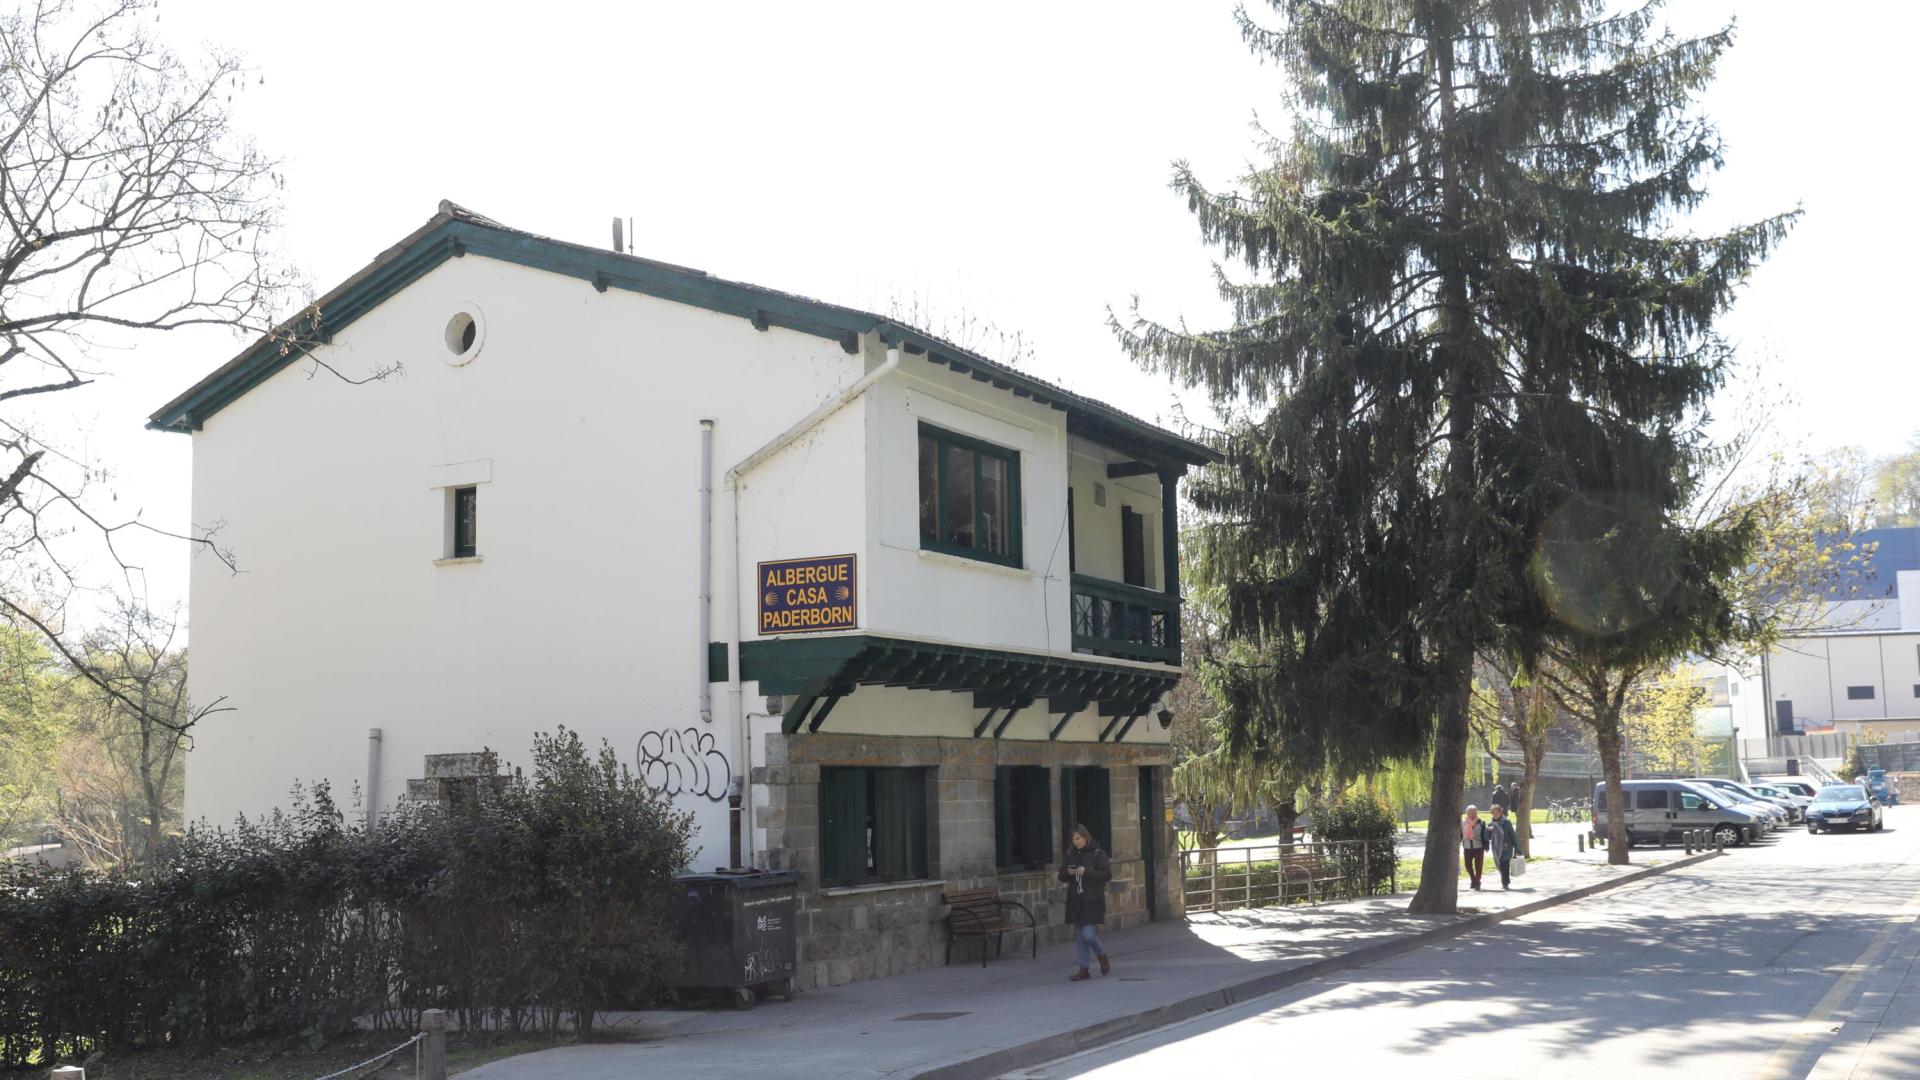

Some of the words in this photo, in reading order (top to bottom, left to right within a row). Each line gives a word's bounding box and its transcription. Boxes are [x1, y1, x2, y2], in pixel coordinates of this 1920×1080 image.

[767, 564, 848, 587] ALBERGUE
[787, 587, 828, 605] CASA
[764, 606, 852, 628] PADERBORN
